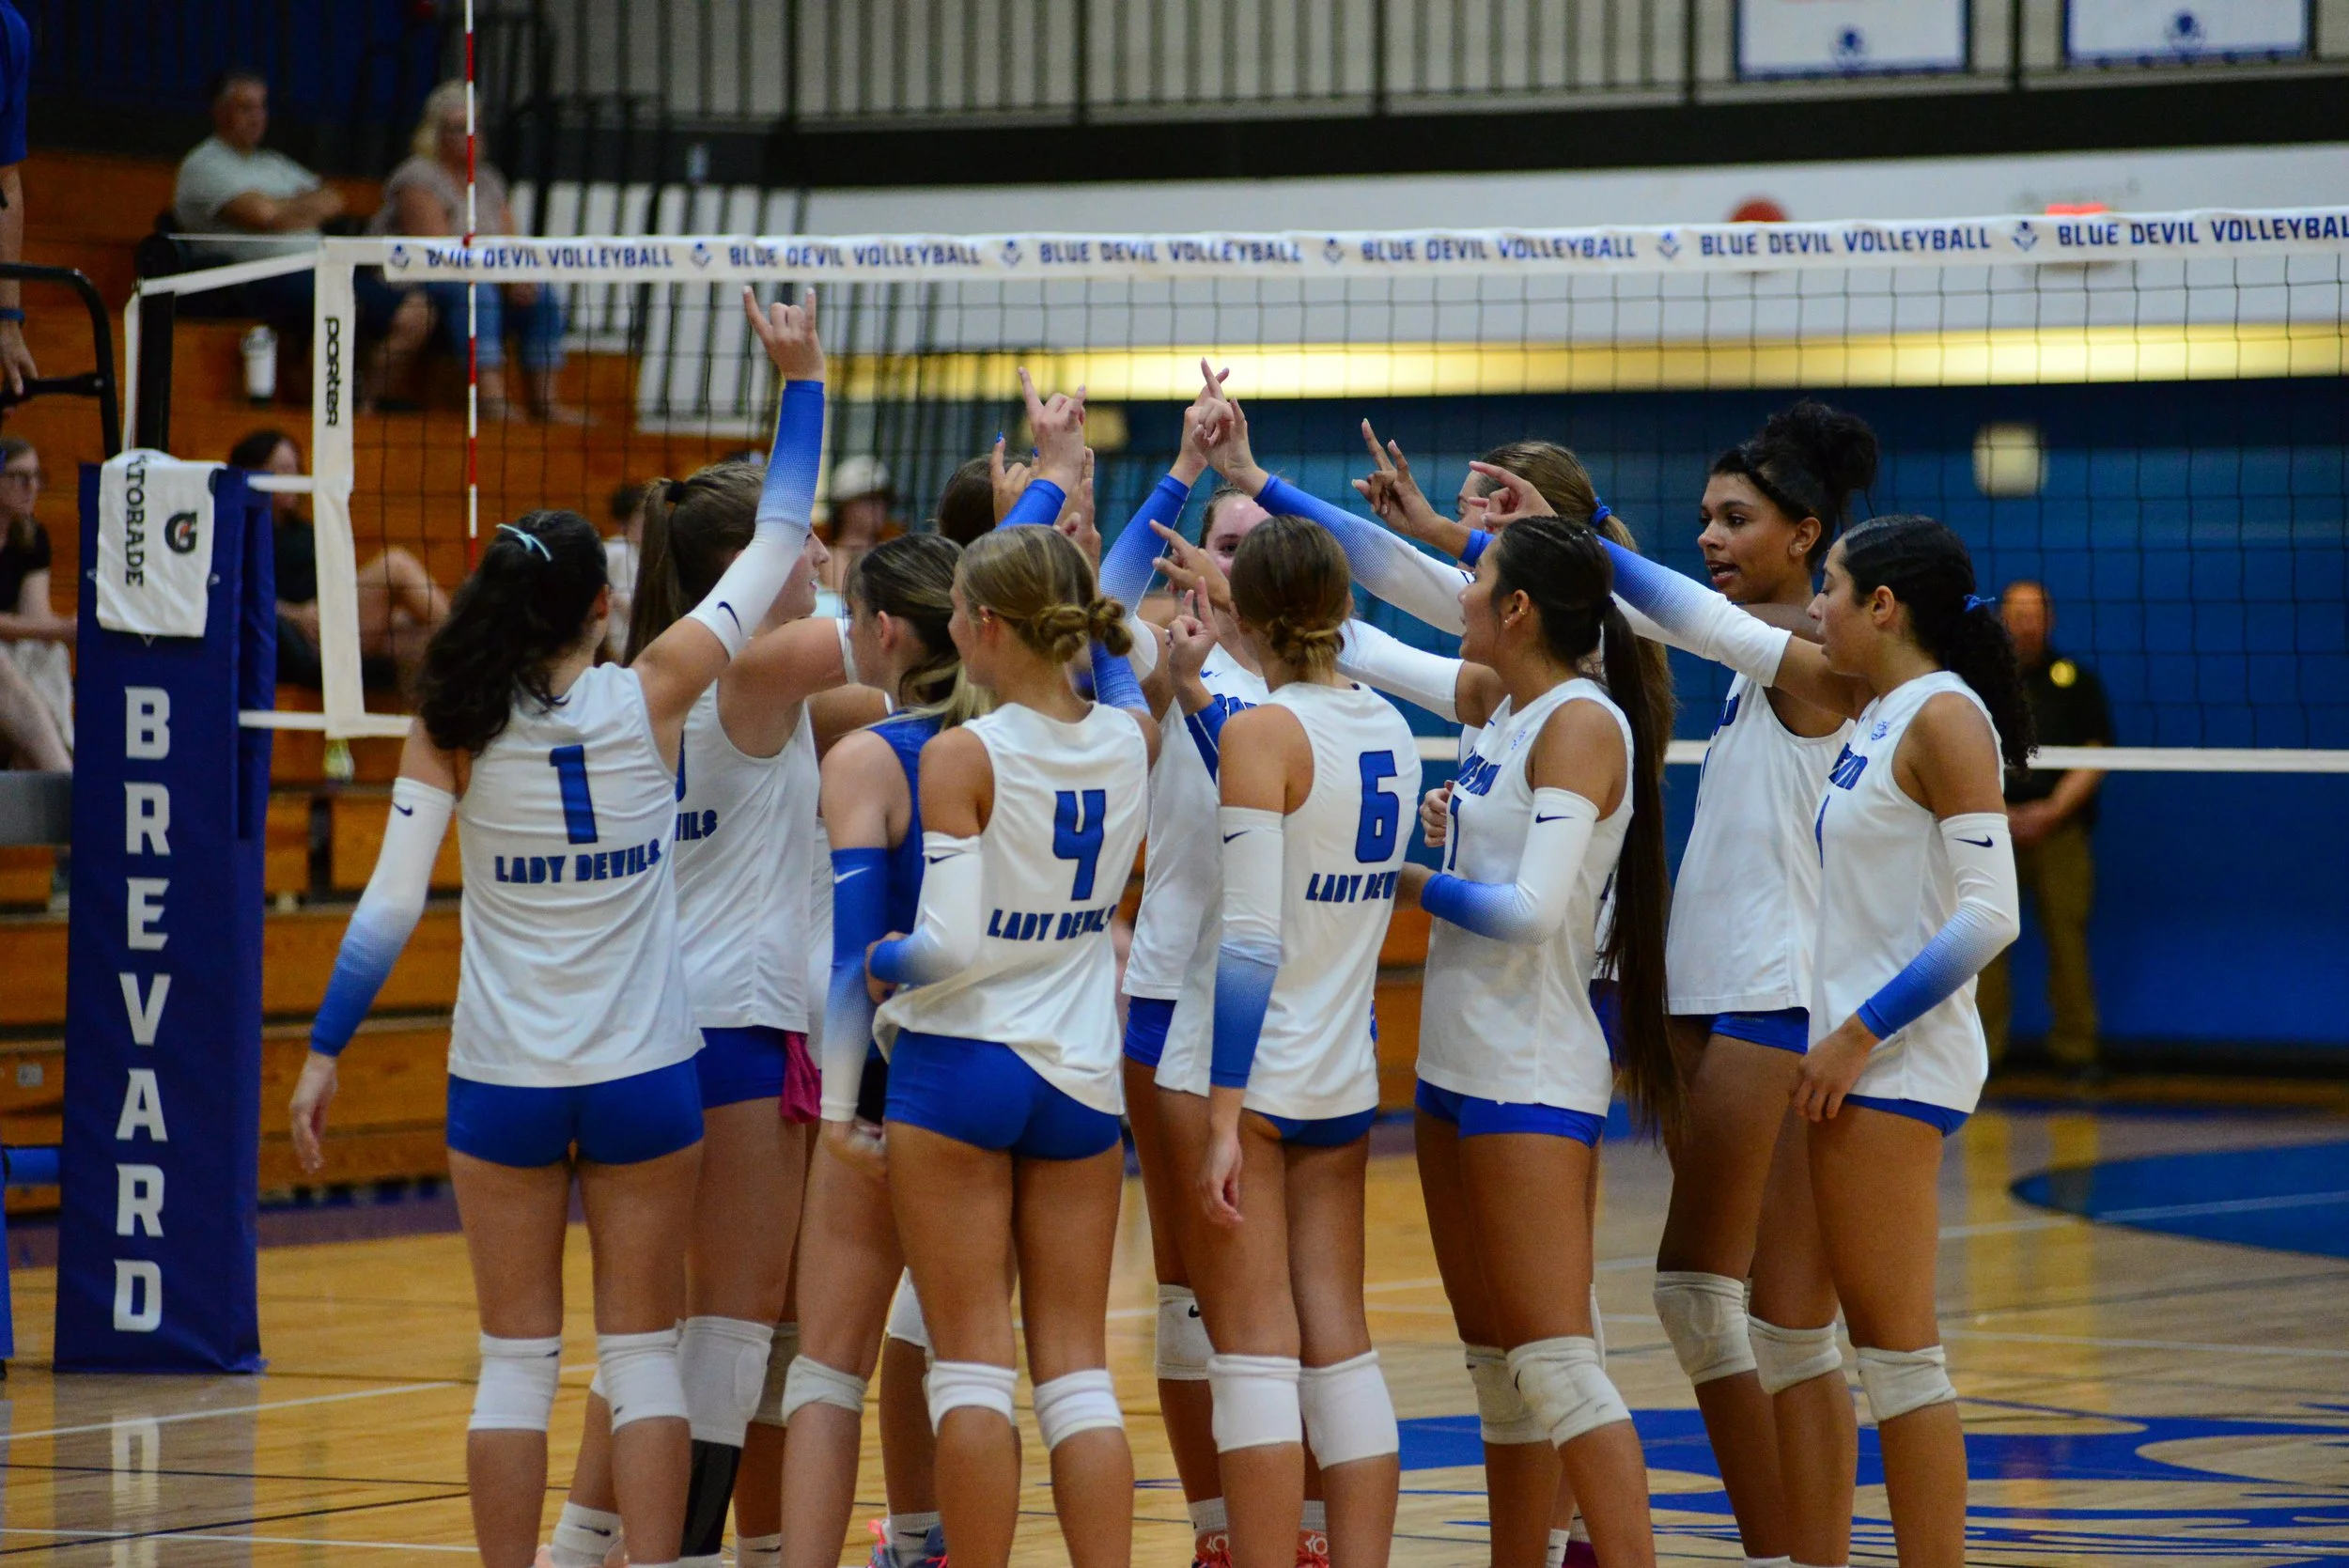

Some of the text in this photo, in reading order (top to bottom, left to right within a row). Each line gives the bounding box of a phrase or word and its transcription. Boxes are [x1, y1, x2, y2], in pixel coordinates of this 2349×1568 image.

[1361, 235, 1636, 261] BLUE DEVIL VOLLEYBALL
[1700, 226, 1993, 256] BLUE DEVIL VOLLEYBALL
[2058, 223, 2120, 247] BLUE
[2130, 220, 2199, 245] DEVIL
[482, 246, 541, 269] DEVIL
[547, 245, 674, 269] VOLLEYBALL
[728, 242, 981, 267] BLUE DEVIL VOLLEYBALL
[1039, 240, 1303, 263] BLUE DEVIL VOLLEYBALL
[550, 744, 598, 845] 1
[1355, 750, 1400, 863] 6
[1052, 789, 1106, 901] 4
[495, 839, 661, 884] LADY DEVILS
[1305, 873, 1362, 903] LADY
[988, 909, 1054, 941] LADY
[113, 686, 172, 1332] BREVARD
